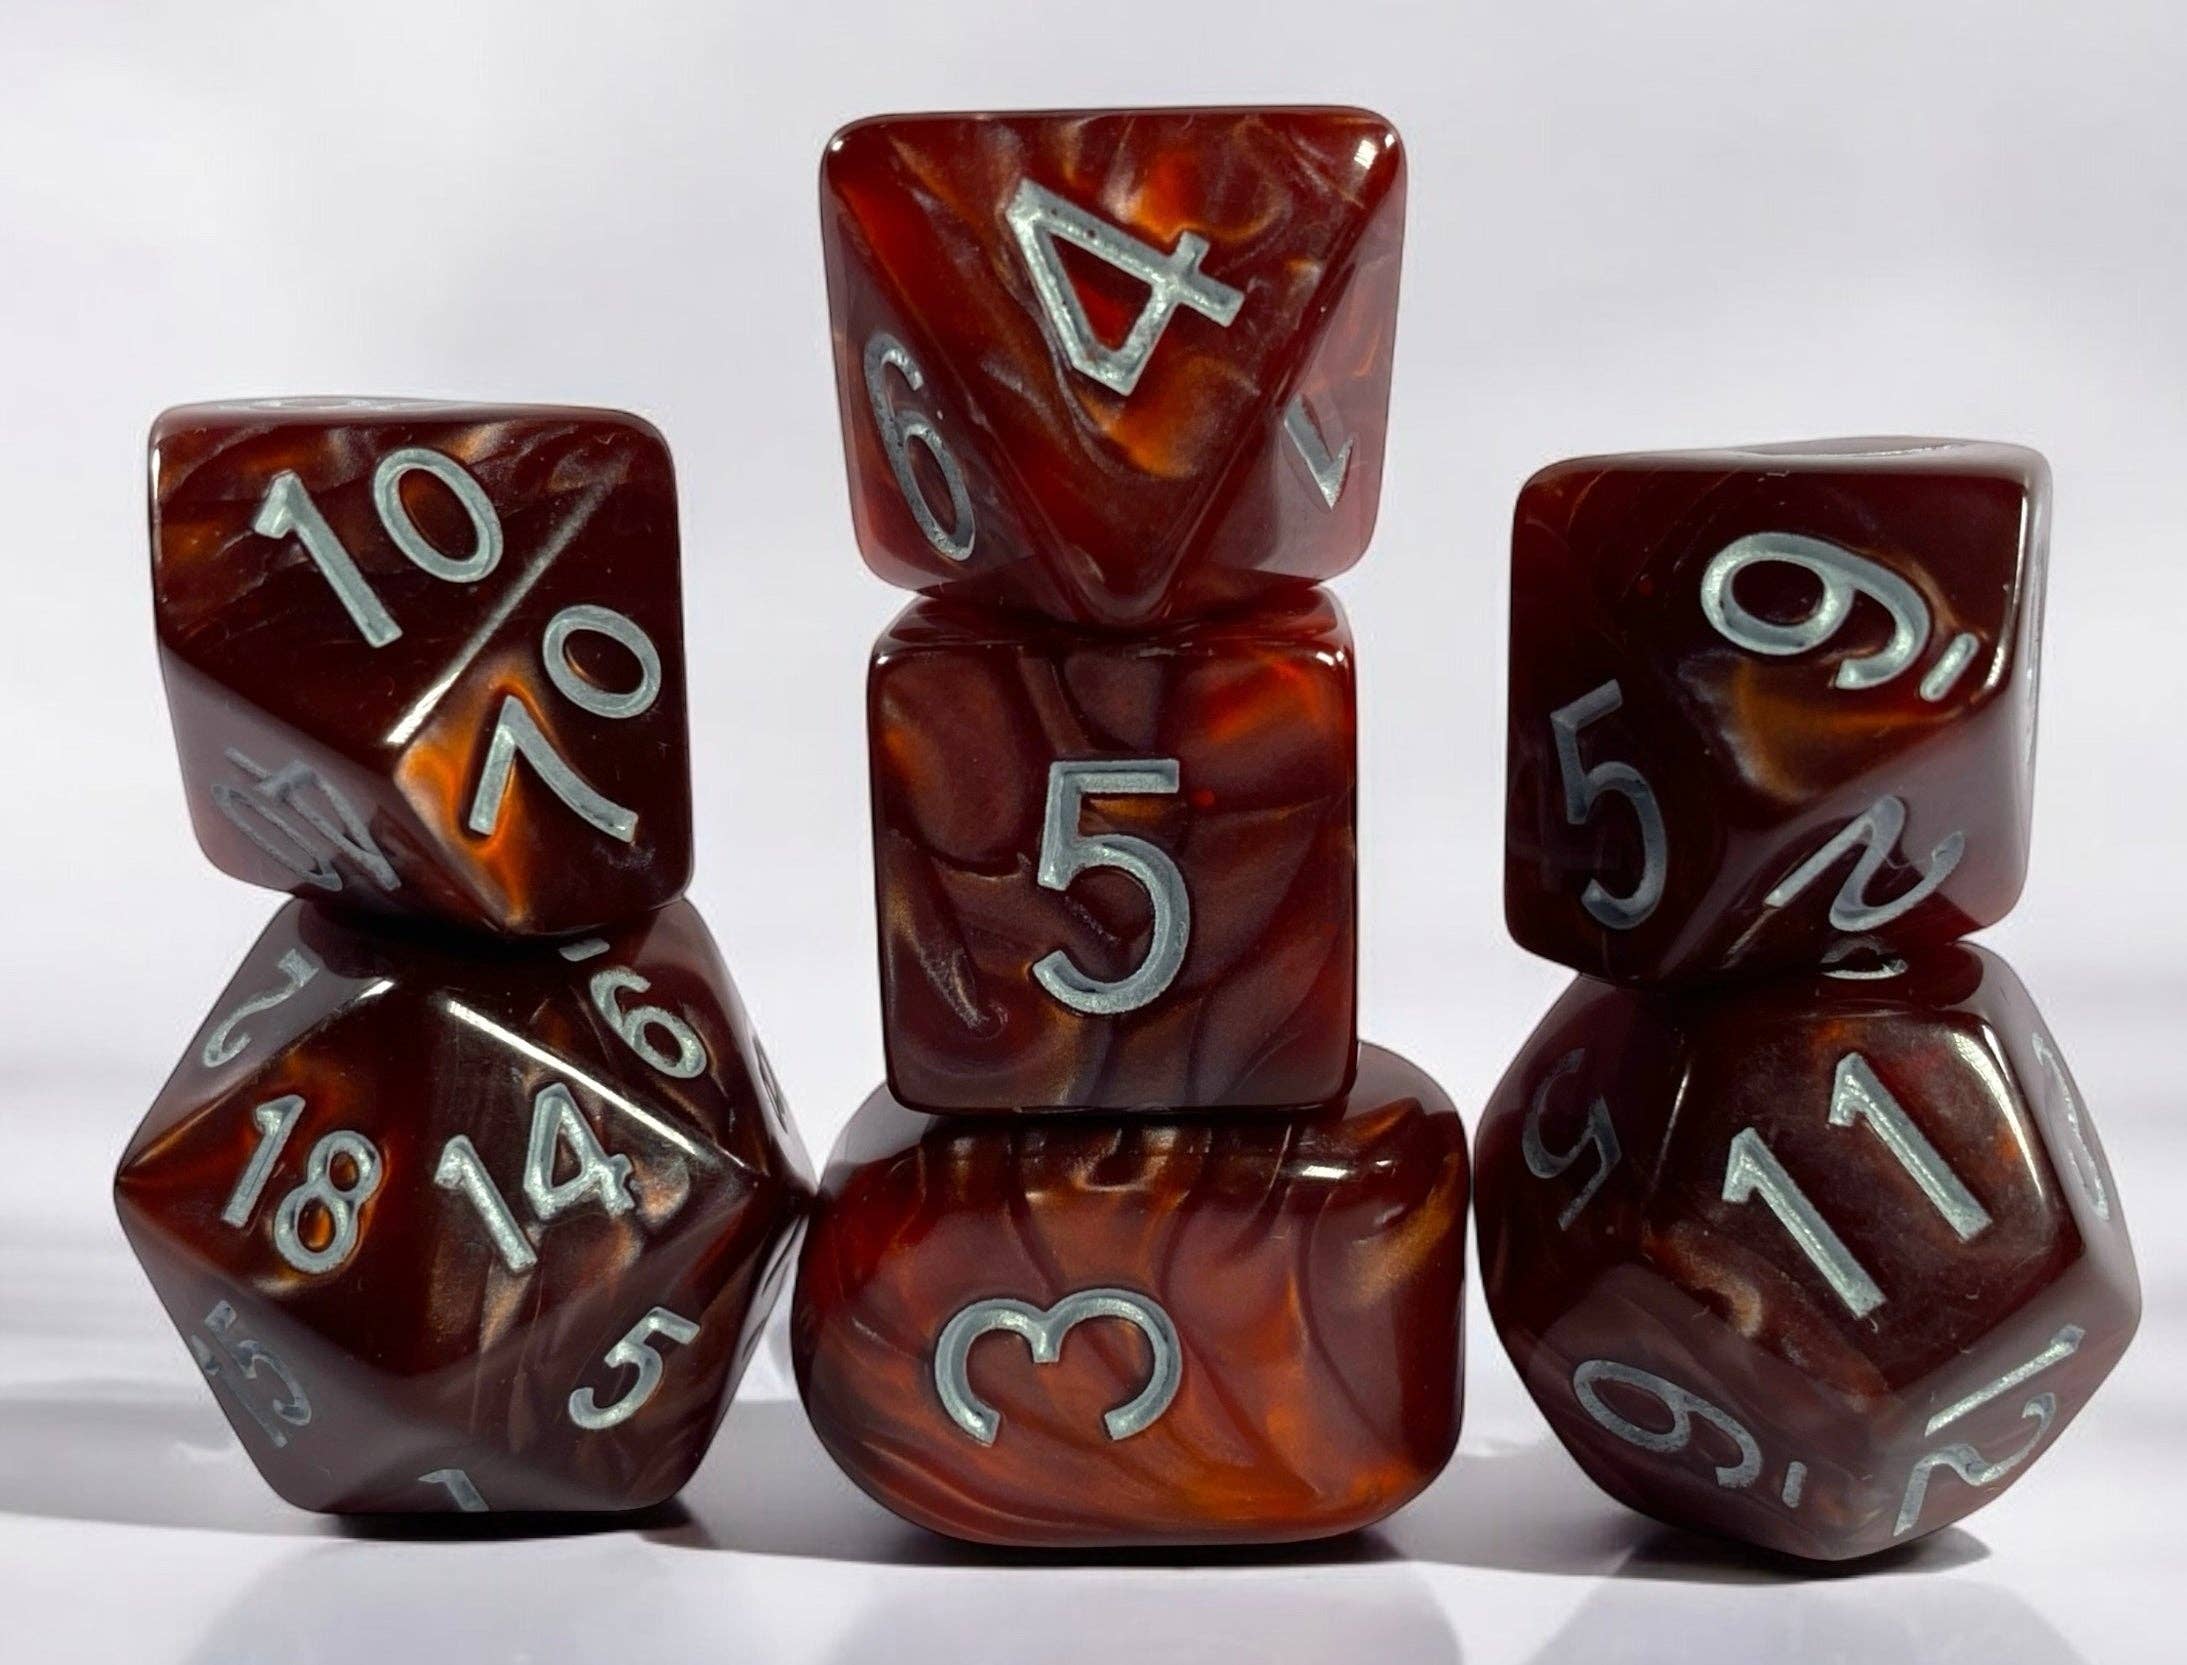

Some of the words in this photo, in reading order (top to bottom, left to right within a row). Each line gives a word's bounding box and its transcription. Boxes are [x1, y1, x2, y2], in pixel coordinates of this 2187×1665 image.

[1006, 178, 1244, 396] 4
[253, 447, 503, 647] 10
[864, 332, 976, 562] 6
[1282, 394, 1353, 512] 1
[1701, 532, 1929, 689] 9
[469, 604, 661, 843] 70
[1550, 679, 1668, 930] 5
[1032, 758, 1191, 1014] 5
[1764, 796, 1965, 932] 2
[223, 1094, 382, 1274] 18
[434, 1082, 635, 1274] 14
[1722, 1052, 1993, 1319] 11
[569, 1307, 700, 1430] 5
[934, 1288, 1182, 1446] 3
[1893, 1324, 2086, 1537] 12
